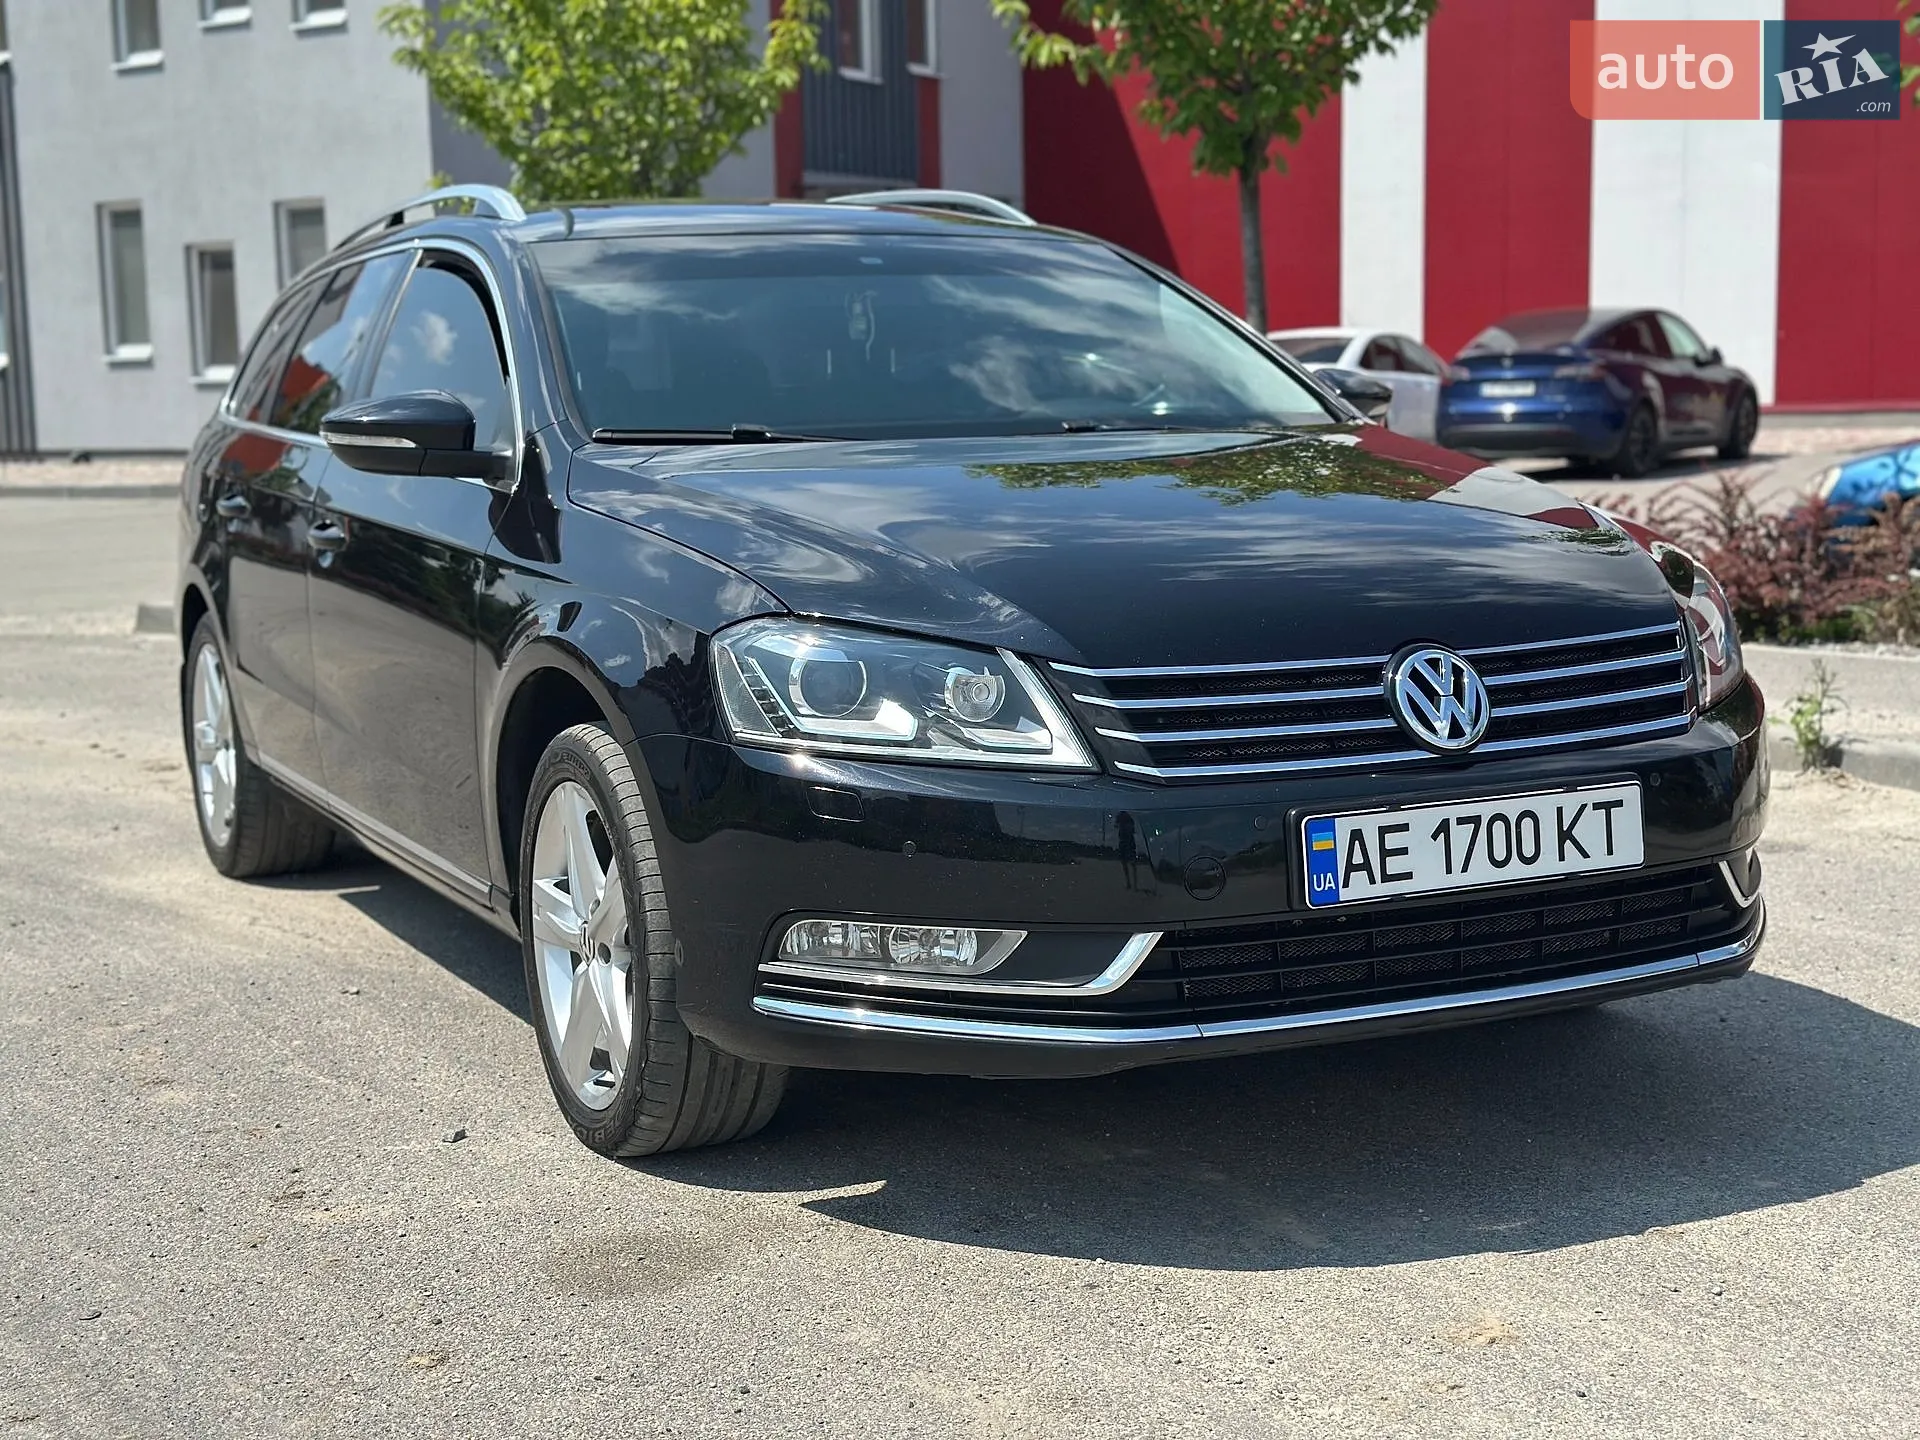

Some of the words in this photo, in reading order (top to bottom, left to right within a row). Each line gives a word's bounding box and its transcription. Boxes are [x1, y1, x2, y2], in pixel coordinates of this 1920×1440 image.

[1341, 822, 1414, 889] AE
[1430, 809, 1540, 875] 1700
[1556, 798, 1624, 862] KT
[1312, 872, 1337, 892] UA
